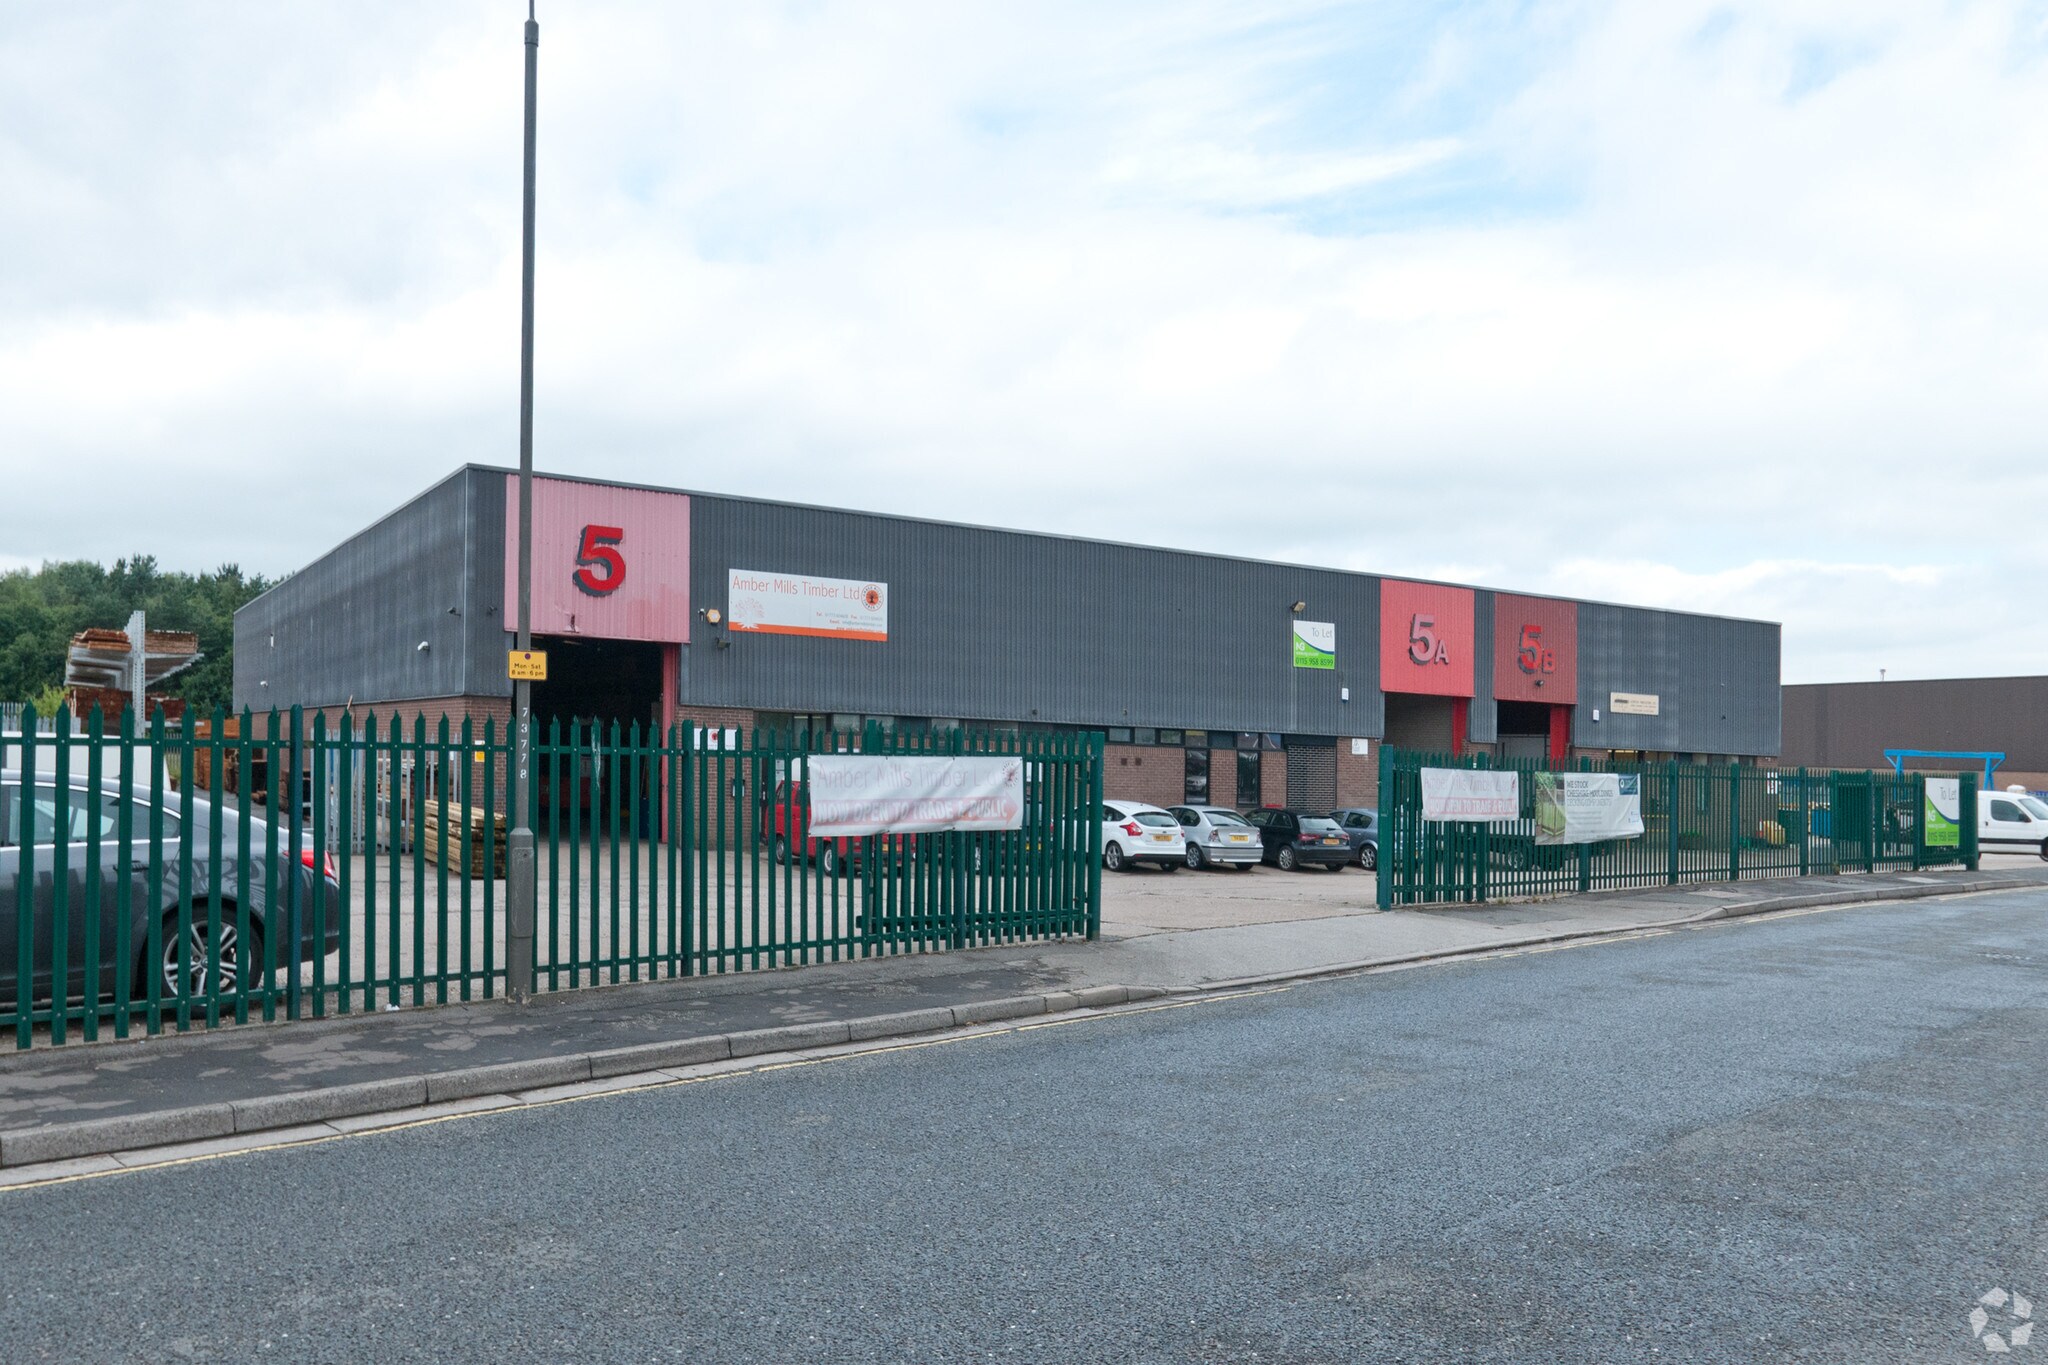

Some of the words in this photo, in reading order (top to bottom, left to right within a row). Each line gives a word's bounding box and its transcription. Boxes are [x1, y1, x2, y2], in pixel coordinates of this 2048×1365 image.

[574, 524, 626, 596] 5
[732, 575, 769, 592] Amber
[774, 579, 798, 595] Mills
[802, 581, 839, 598] Timber
[843, 585, 860, 600] Ltd
[1312, 627, 1320, 637] To
[1322, 628, 1332, 638] Let
[1410, 613, 1449, 664] 5A
[1519, 624, 1556, 673] 5B
[816, 763, 869, 788] Amber
[876, 764, 912, 788] Mills
[919, 765, 968, 788] Timber
[816, 801, 851, 823] NOW
[854, 801, 888, 822] OPEN
[894, 802, 909, 820] TO
[914, 801, 953, 820] TRADE
[967, 799, 1008, 818] PUBLIC
